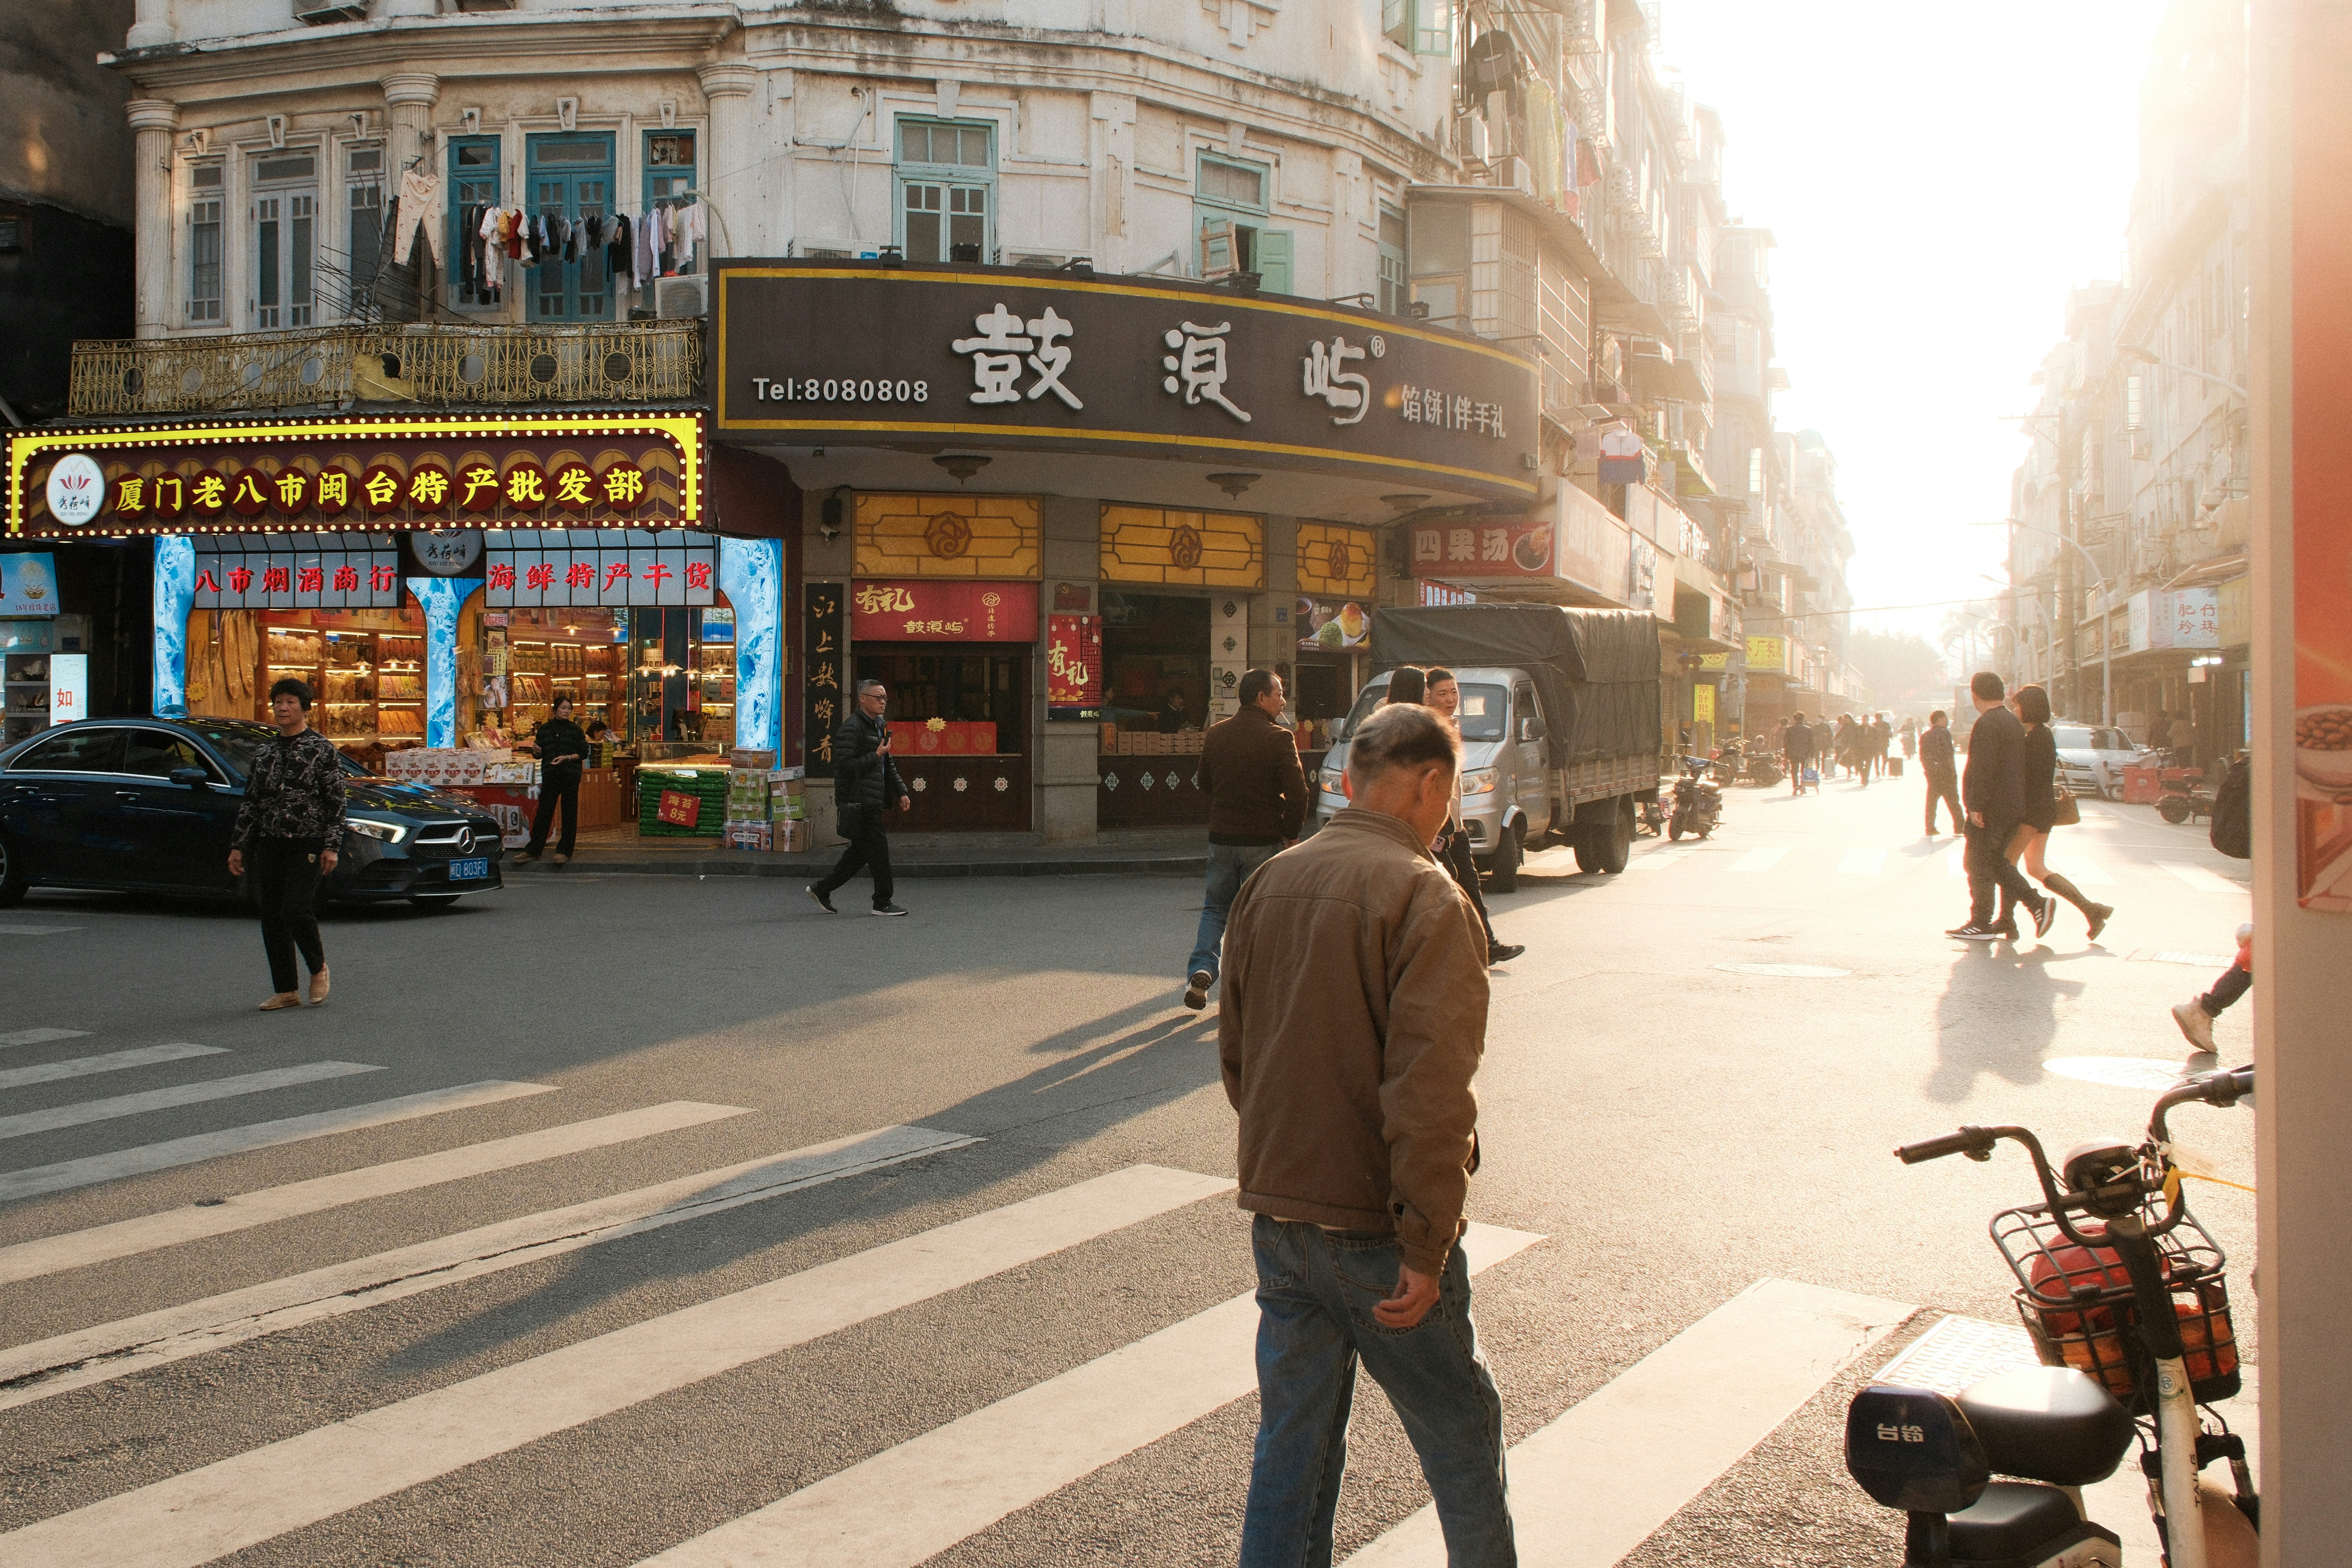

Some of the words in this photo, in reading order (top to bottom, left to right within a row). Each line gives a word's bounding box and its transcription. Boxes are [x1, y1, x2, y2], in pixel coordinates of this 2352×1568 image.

[752, 378, 928, 402] Tel:8080808
[115, 468, 644, 511] 厦门老八市闽台特产批发部
[1415, 528, 1509, 561] 四果汤
[195, 564, 397, 593] 八市烟酒商行
[486, 562, 712, 592] 海鲜特产干货
[15, 603, 56, 612] 18年珍珠老店
[856, 585, 915, 614] 有礼
[2178, 603, 2216, 617] 肥仔
[903, 620, 963, 635] 鼓浪屿
[987, 607, 996, 637] 非遗传承
[2177, 619, 2218, 634] 珍珠
[1048, 640, 1088, 685] 有礼
[668, 795, 693, 809] 海苔
[670, 808, 687, 821] 8元
[1877, 1423, 1924, 1442] 台铃
[2190, 1454, 2201, 1508] TAILG
